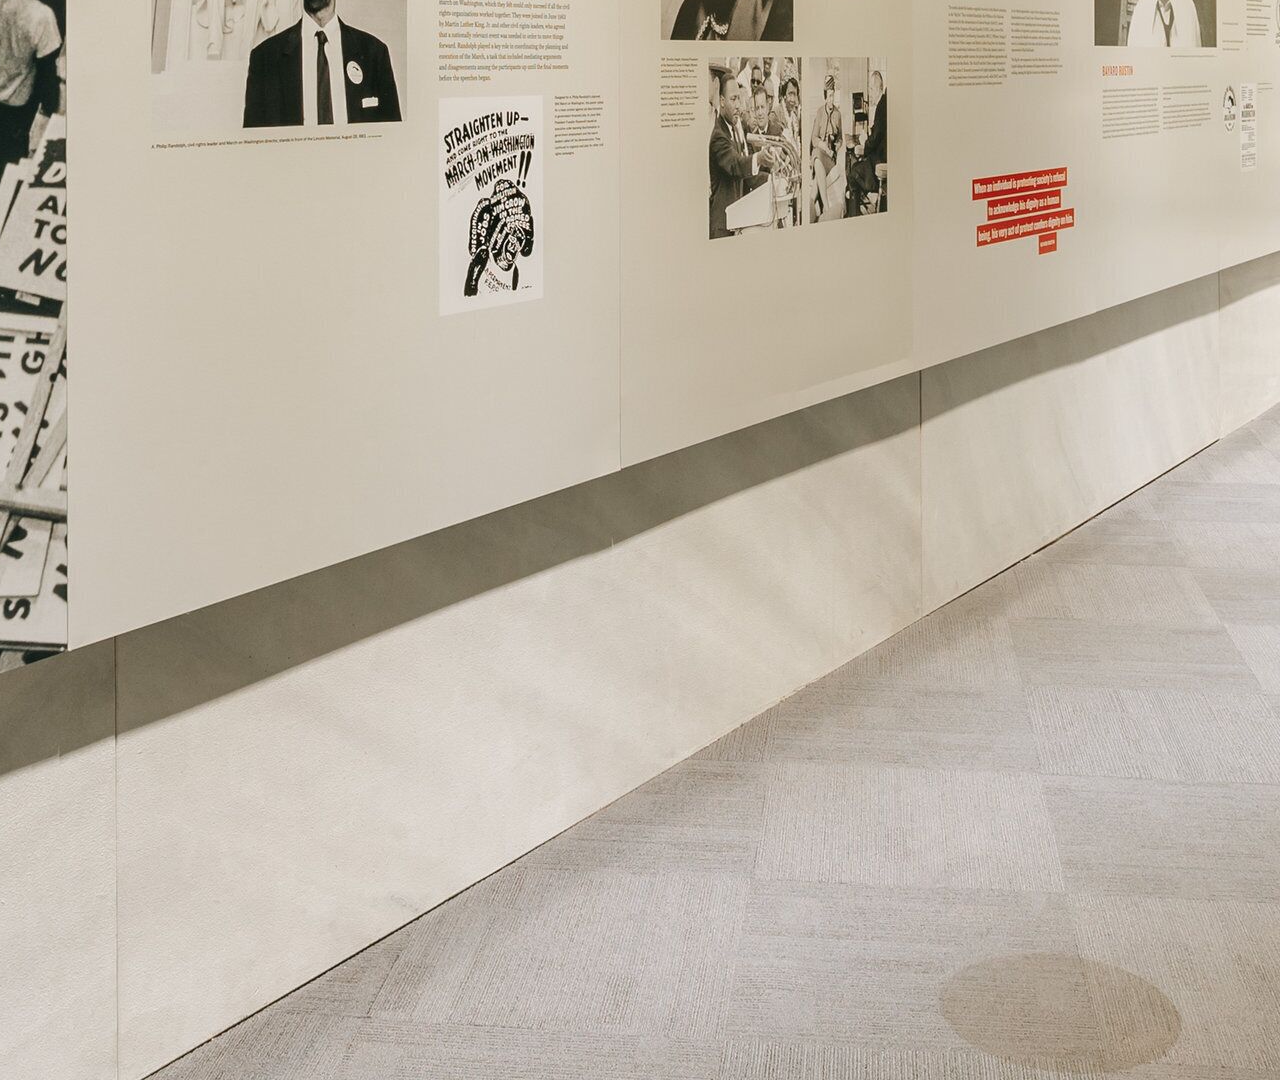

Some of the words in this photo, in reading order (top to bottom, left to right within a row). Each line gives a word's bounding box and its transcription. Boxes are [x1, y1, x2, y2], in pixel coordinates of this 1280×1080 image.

[444, 112, 503, 153] STRAIGHTEN
[447, 153, 457, 164] AND
[458, 145, 472, 156] COME
[473, 136, 488, 149] RIGHT
